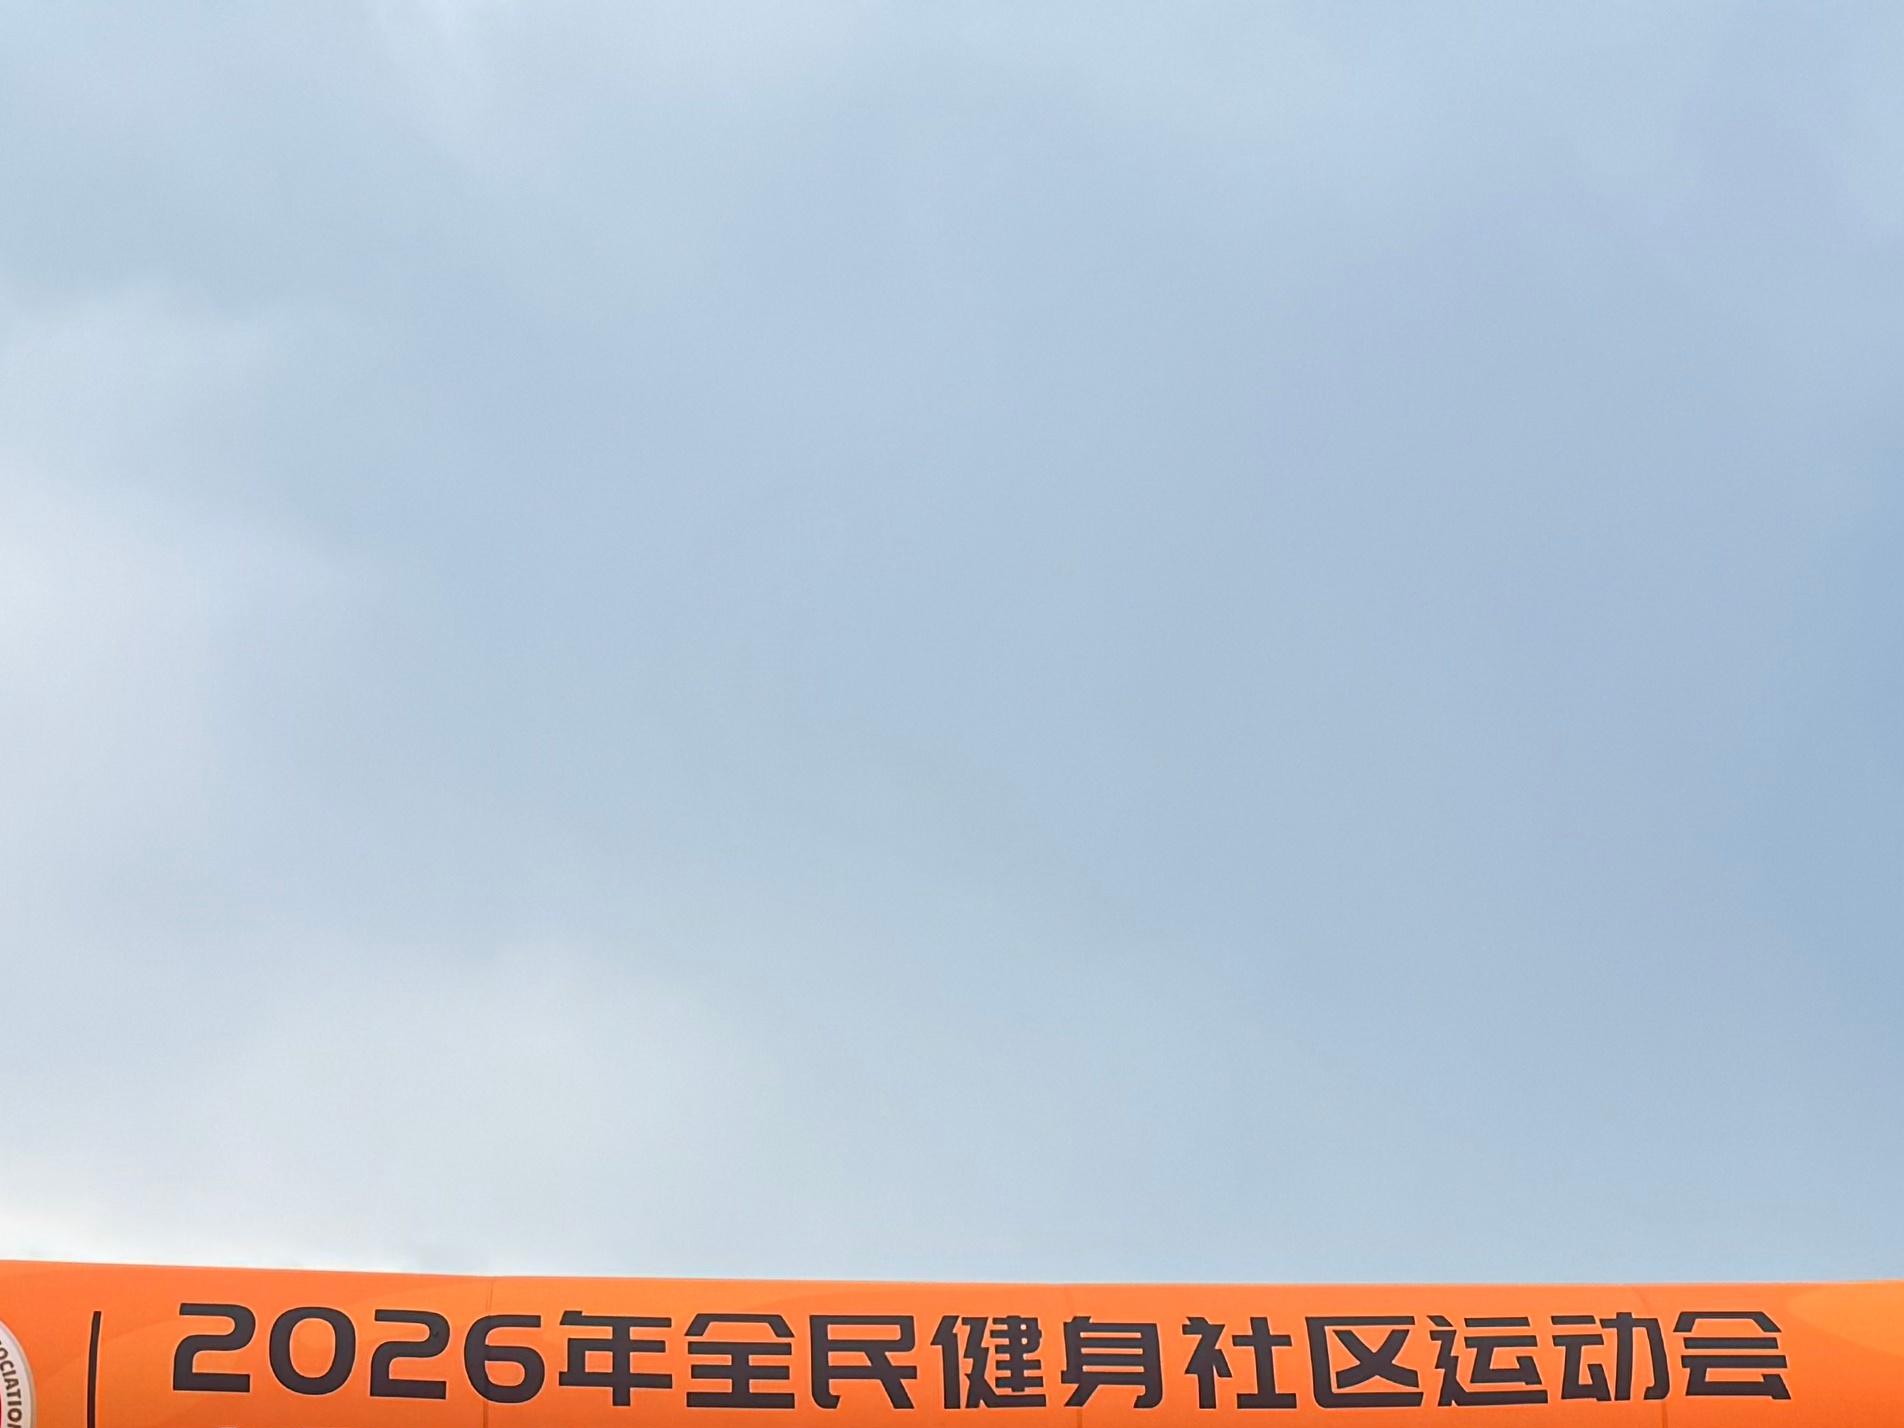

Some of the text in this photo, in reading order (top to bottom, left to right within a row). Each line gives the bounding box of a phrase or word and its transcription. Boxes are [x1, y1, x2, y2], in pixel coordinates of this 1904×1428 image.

[170, 1303, 1793, 1408] 2026年全民健身社区运动会
